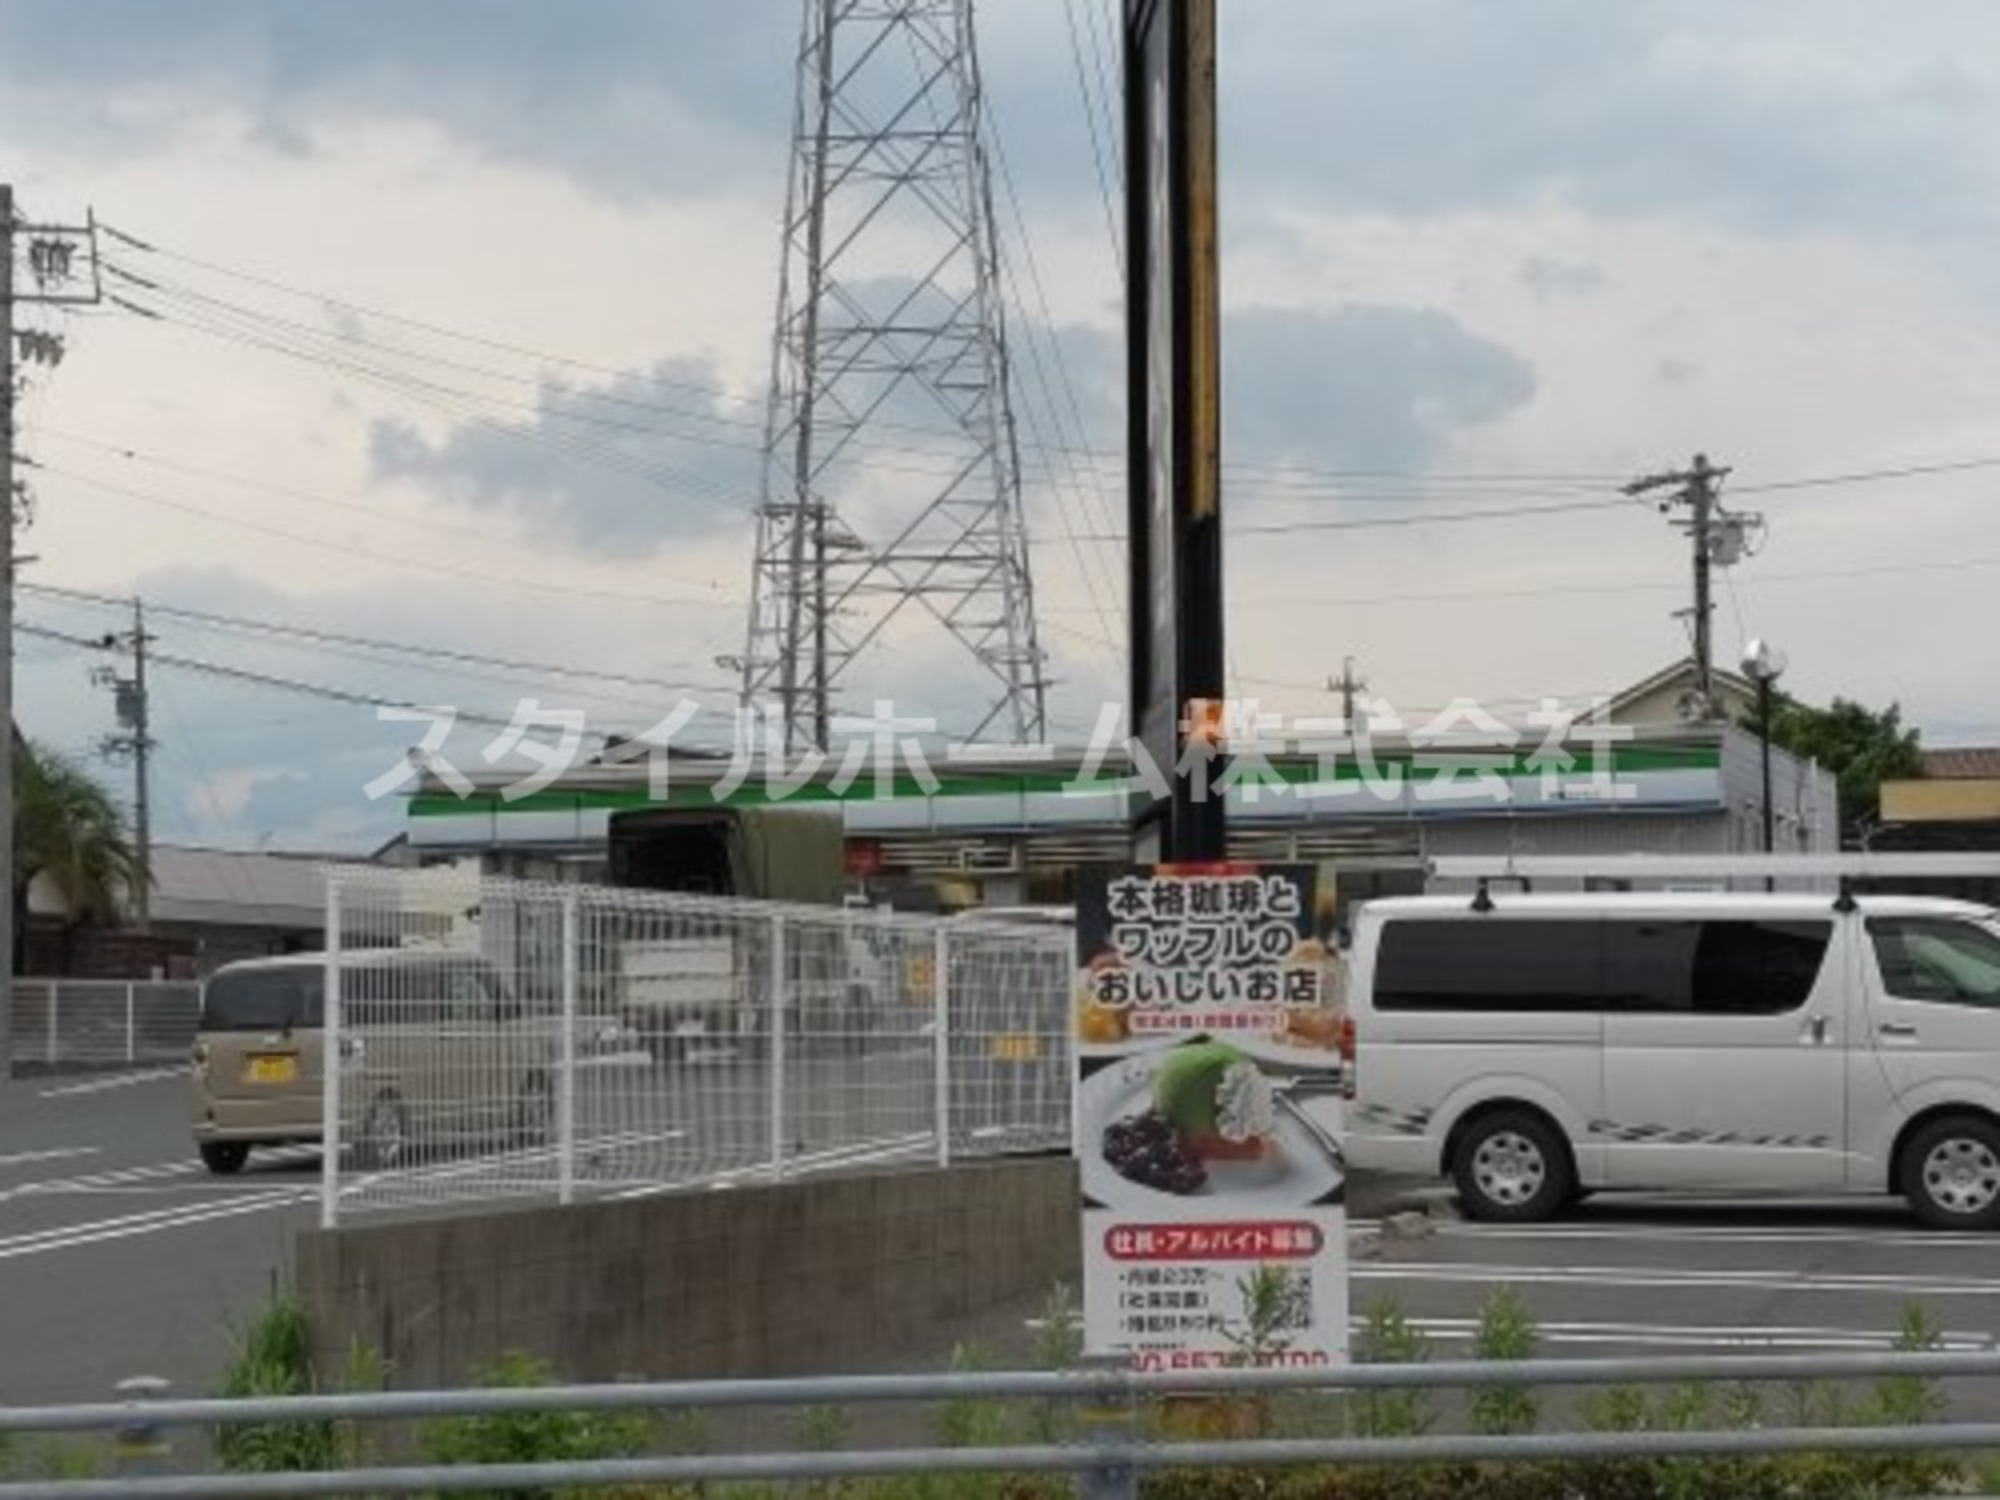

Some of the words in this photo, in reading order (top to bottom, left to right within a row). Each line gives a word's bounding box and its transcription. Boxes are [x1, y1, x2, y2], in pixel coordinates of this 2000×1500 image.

[1108, 876, 1299, 918] 本格珈琲と
[1116, 924, 1295, 959] ワッフルの
